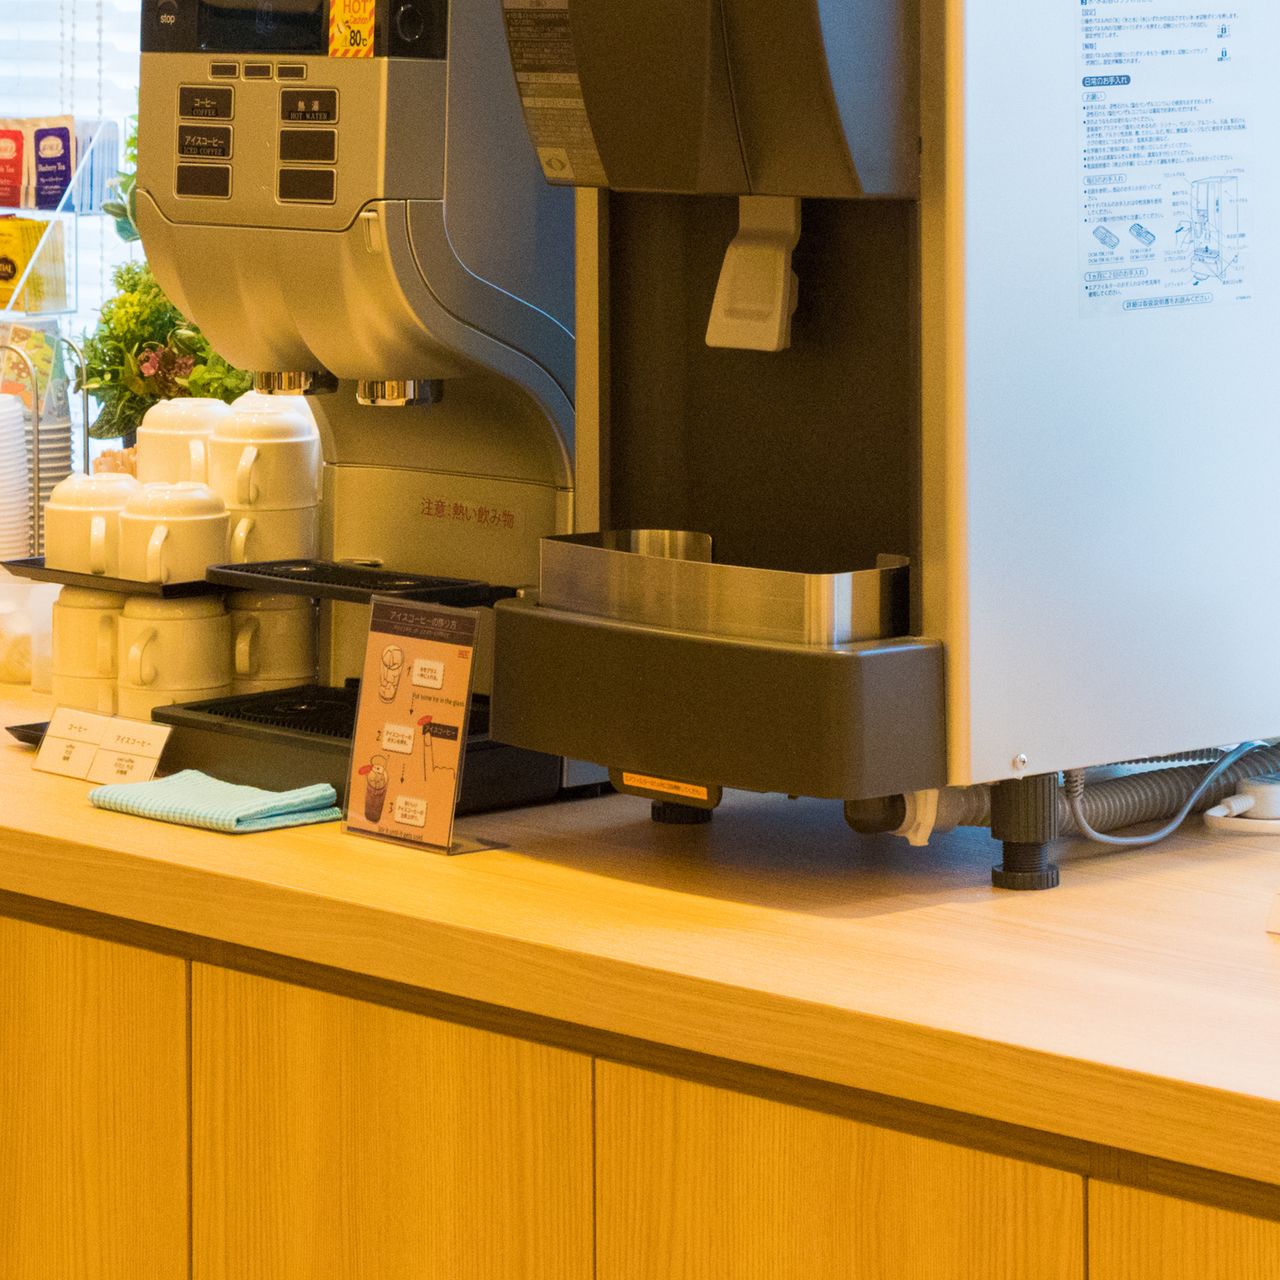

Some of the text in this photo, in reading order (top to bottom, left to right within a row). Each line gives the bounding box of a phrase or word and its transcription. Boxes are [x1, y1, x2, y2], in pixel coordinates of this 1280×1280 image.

[343, 0, 369, 14] HOT
[160, 13, 176, 25] stop
[194, 97, 217, 107] コーヒー
[193, 108, 216, 117] COFFEE
[184, 135, 224, 146] アイスコーヒー
[390, 610, 457, 630] アイスコーヒーの作り方
[68, 723, 88, 732] コーヒー
[116, 735, 151, 747] アイスコーヒー
